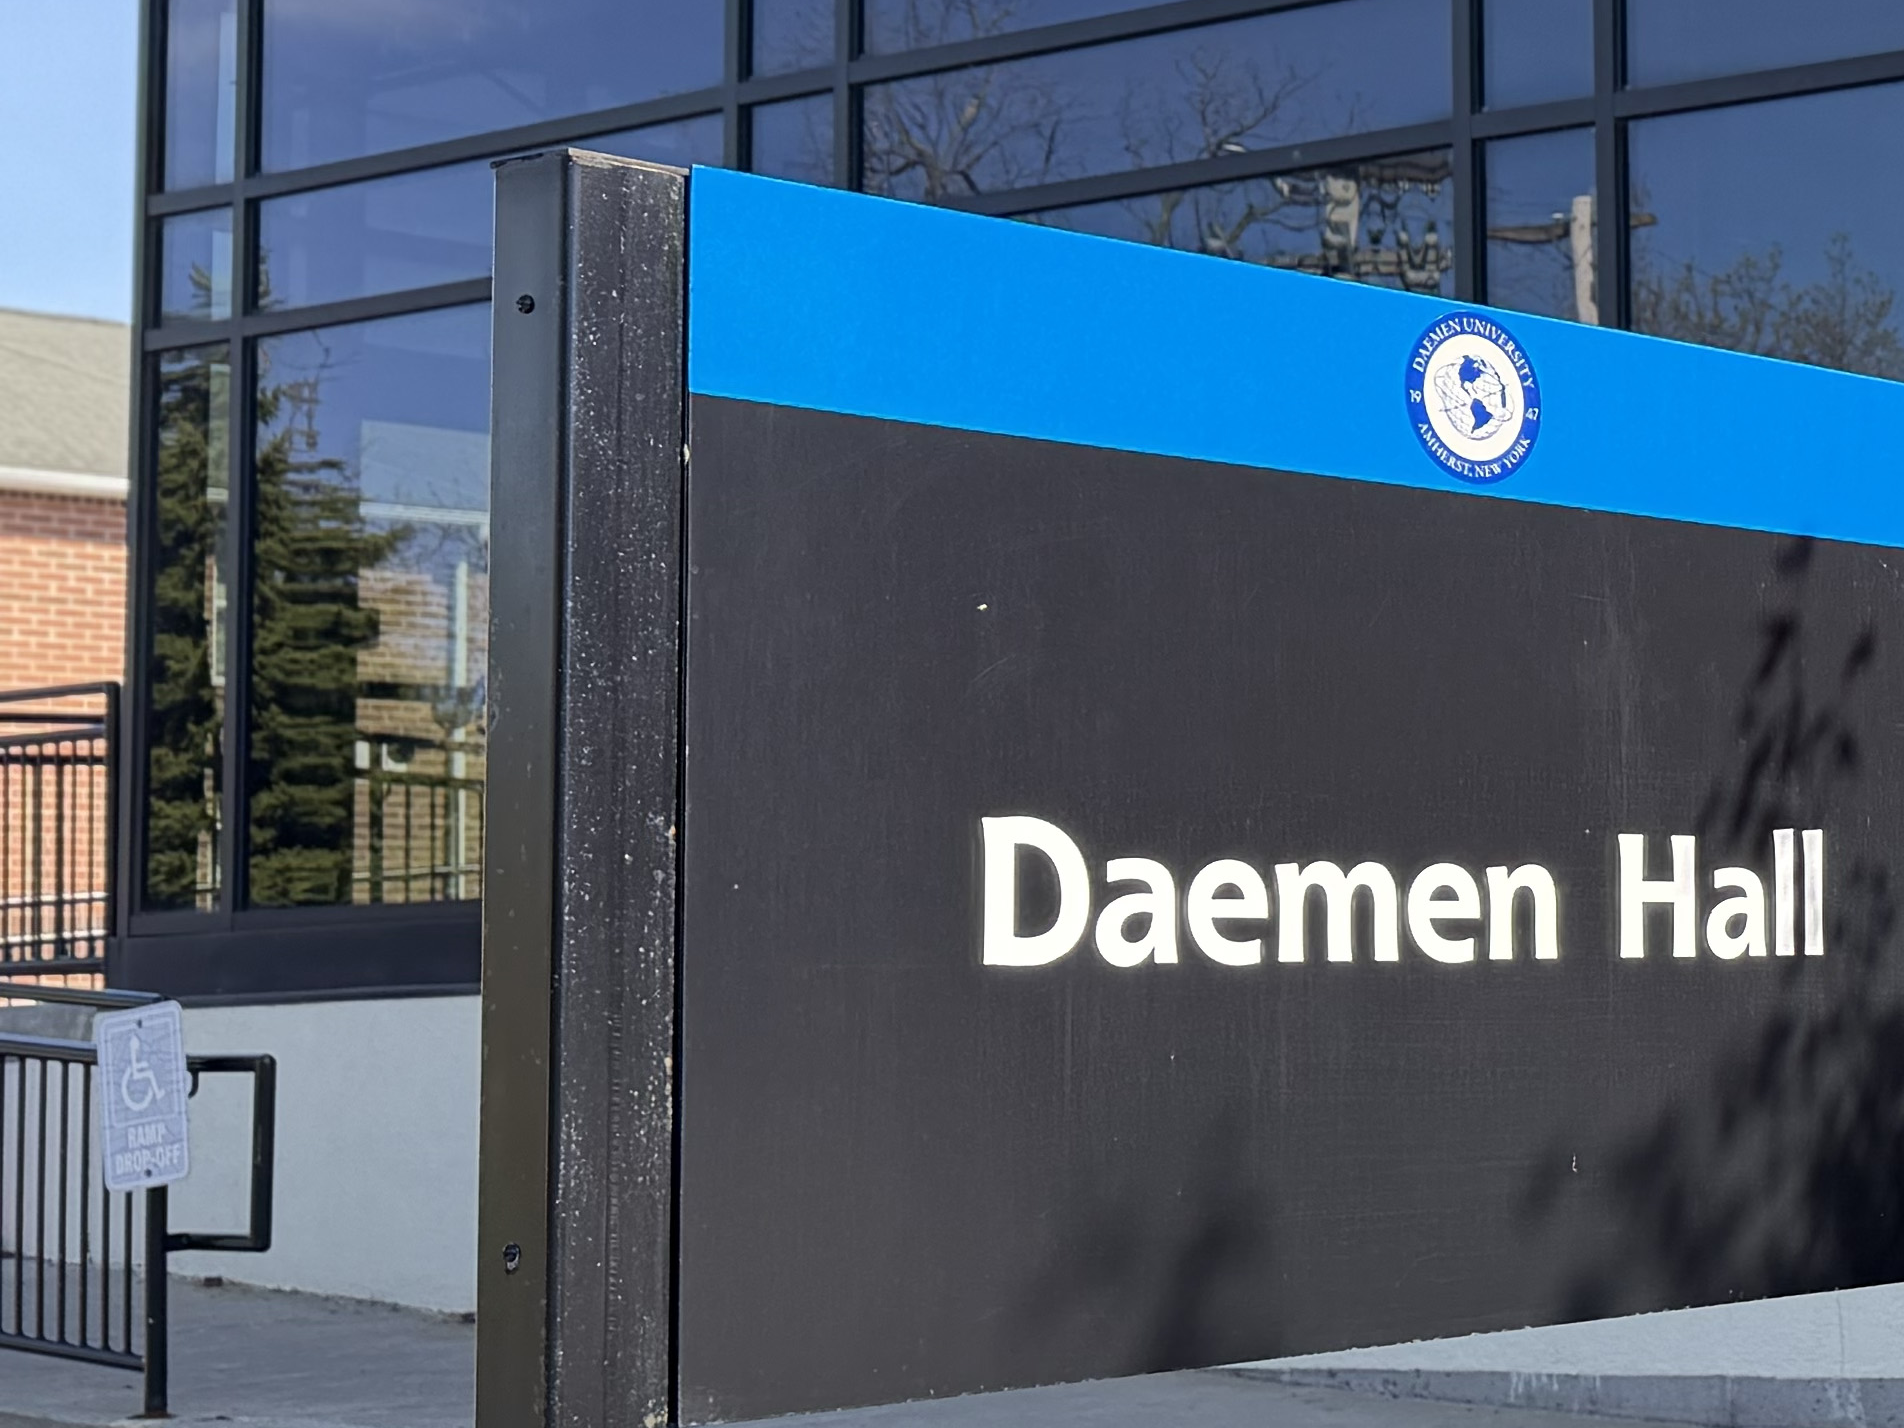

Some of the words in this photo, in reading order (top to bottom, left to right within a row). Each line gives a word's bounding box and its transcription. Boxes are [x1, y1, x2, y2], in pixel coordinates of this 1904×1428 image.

[1412, 318, 1462, 373] DAEMEN
[1463, 318, 1534, 388] UNIVERSITY
[1525, 407, 1539, 421] 47
[1474, 461, 1502, 478] NEW
[1503, 436, 1531, 469] YORK
[981, 815, 1560, 968] Daemen
[1617, 828, 1824, 959] Hall
[127, 1122, 167, 1149] RAMP
[115, 1143, 181, 1174] DROP-OFF
